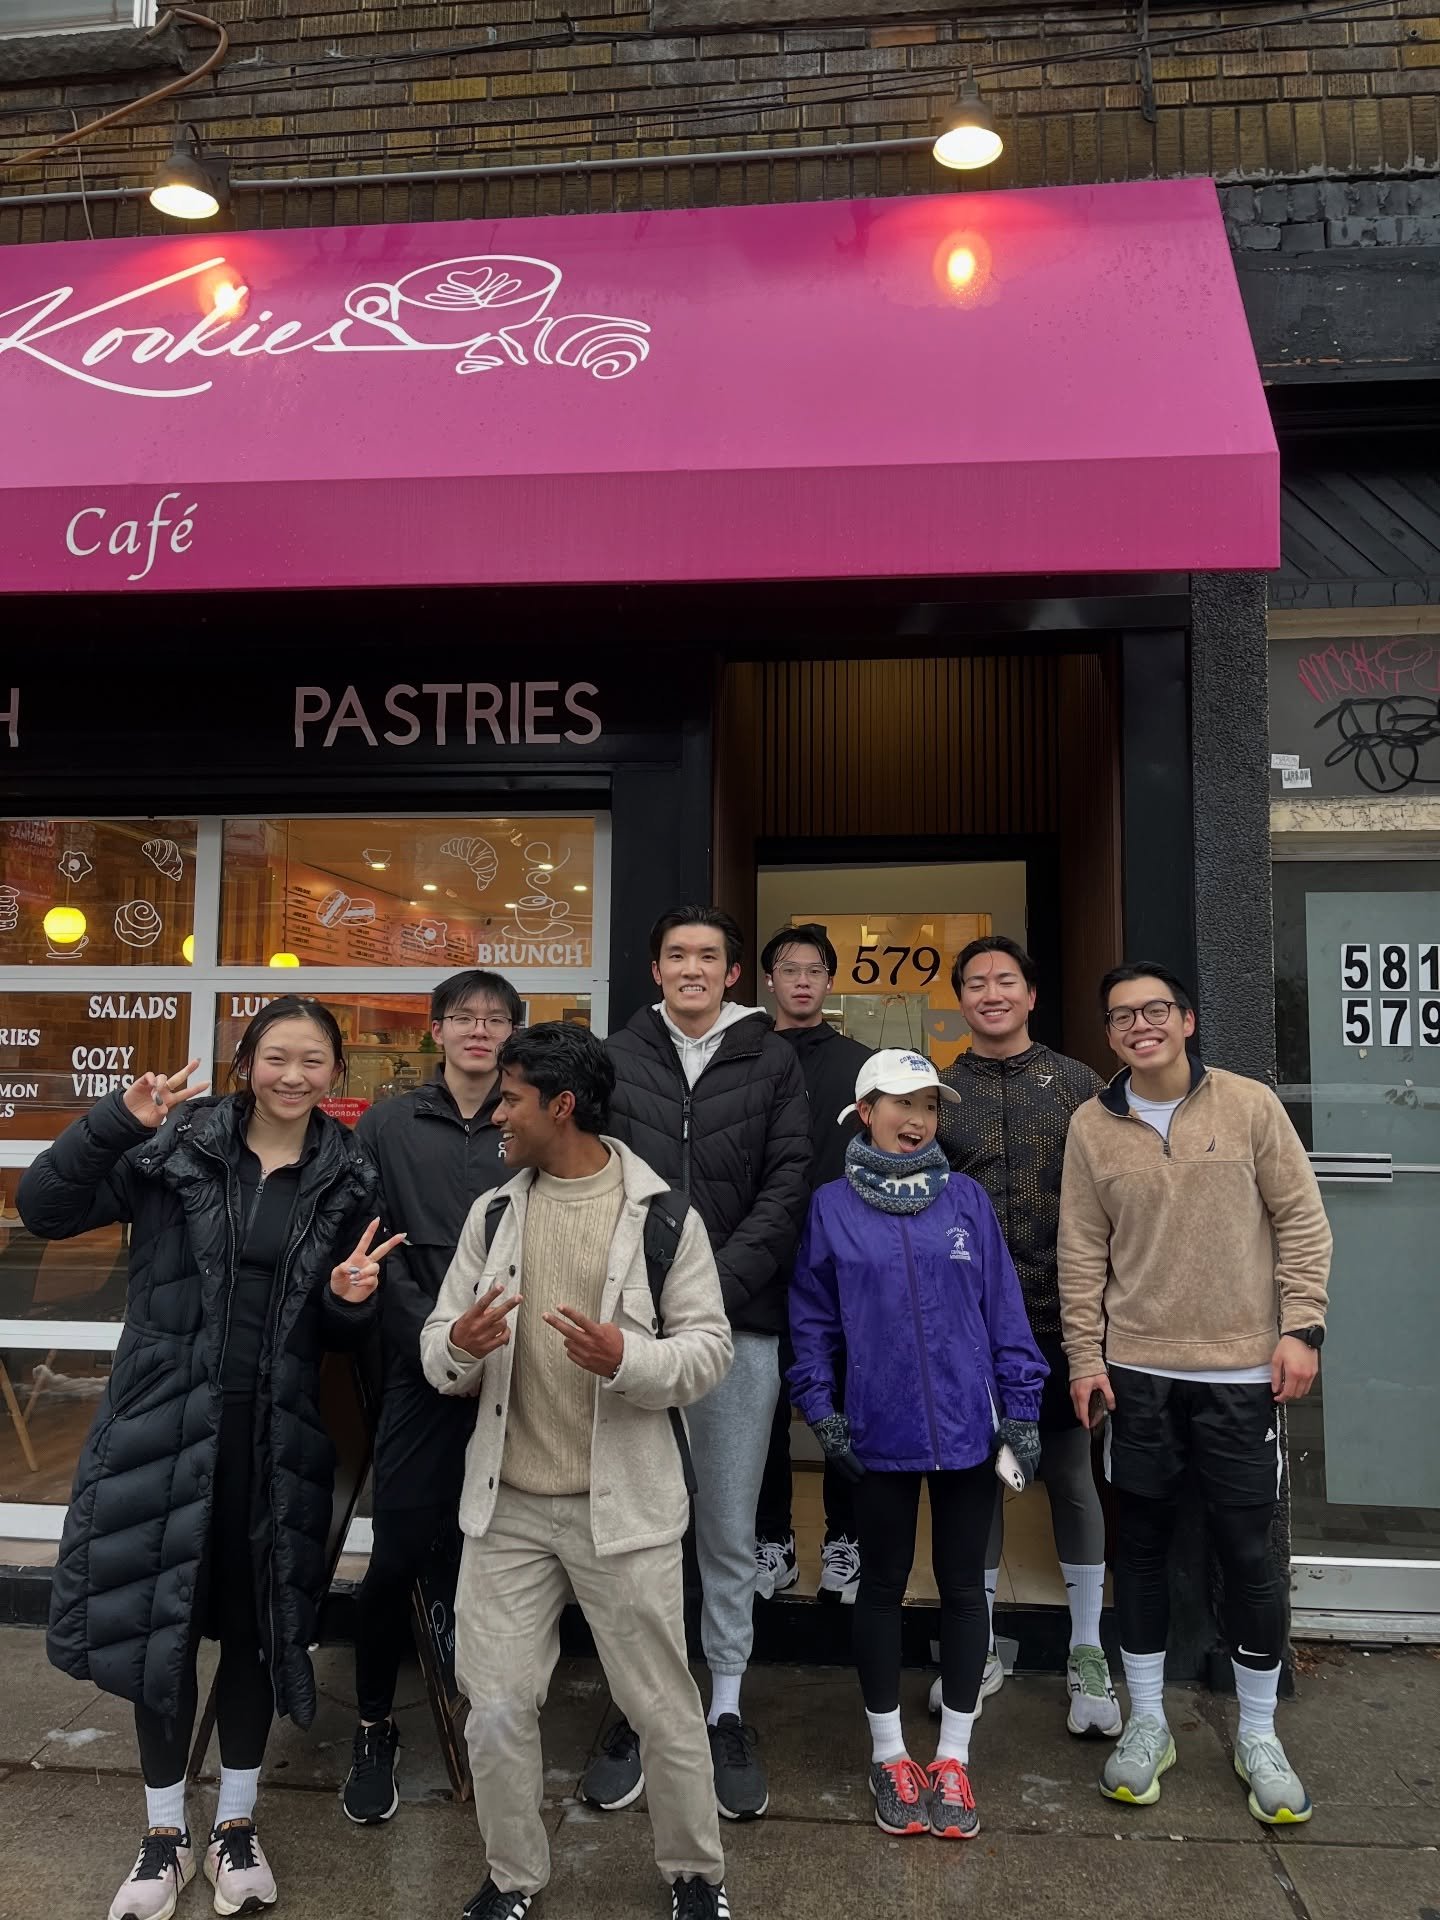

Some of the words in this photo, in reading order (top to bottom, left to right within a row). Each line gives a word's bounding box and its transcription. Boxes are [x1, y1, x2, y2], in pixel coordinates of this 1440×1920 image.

[65, 492, 198, 580] Café
[295, 681, 602, 747] PASTRIES
[477, 943, 583, 965] BRUNCH
[851, 945, 940, 986] 579
[1343, 945, 1439, 989] 581
[88, 995, 178, 1019] SALADS
[1345, 999, 1440, 1045] 579
[71, 1045, 135, 1070] COZY
